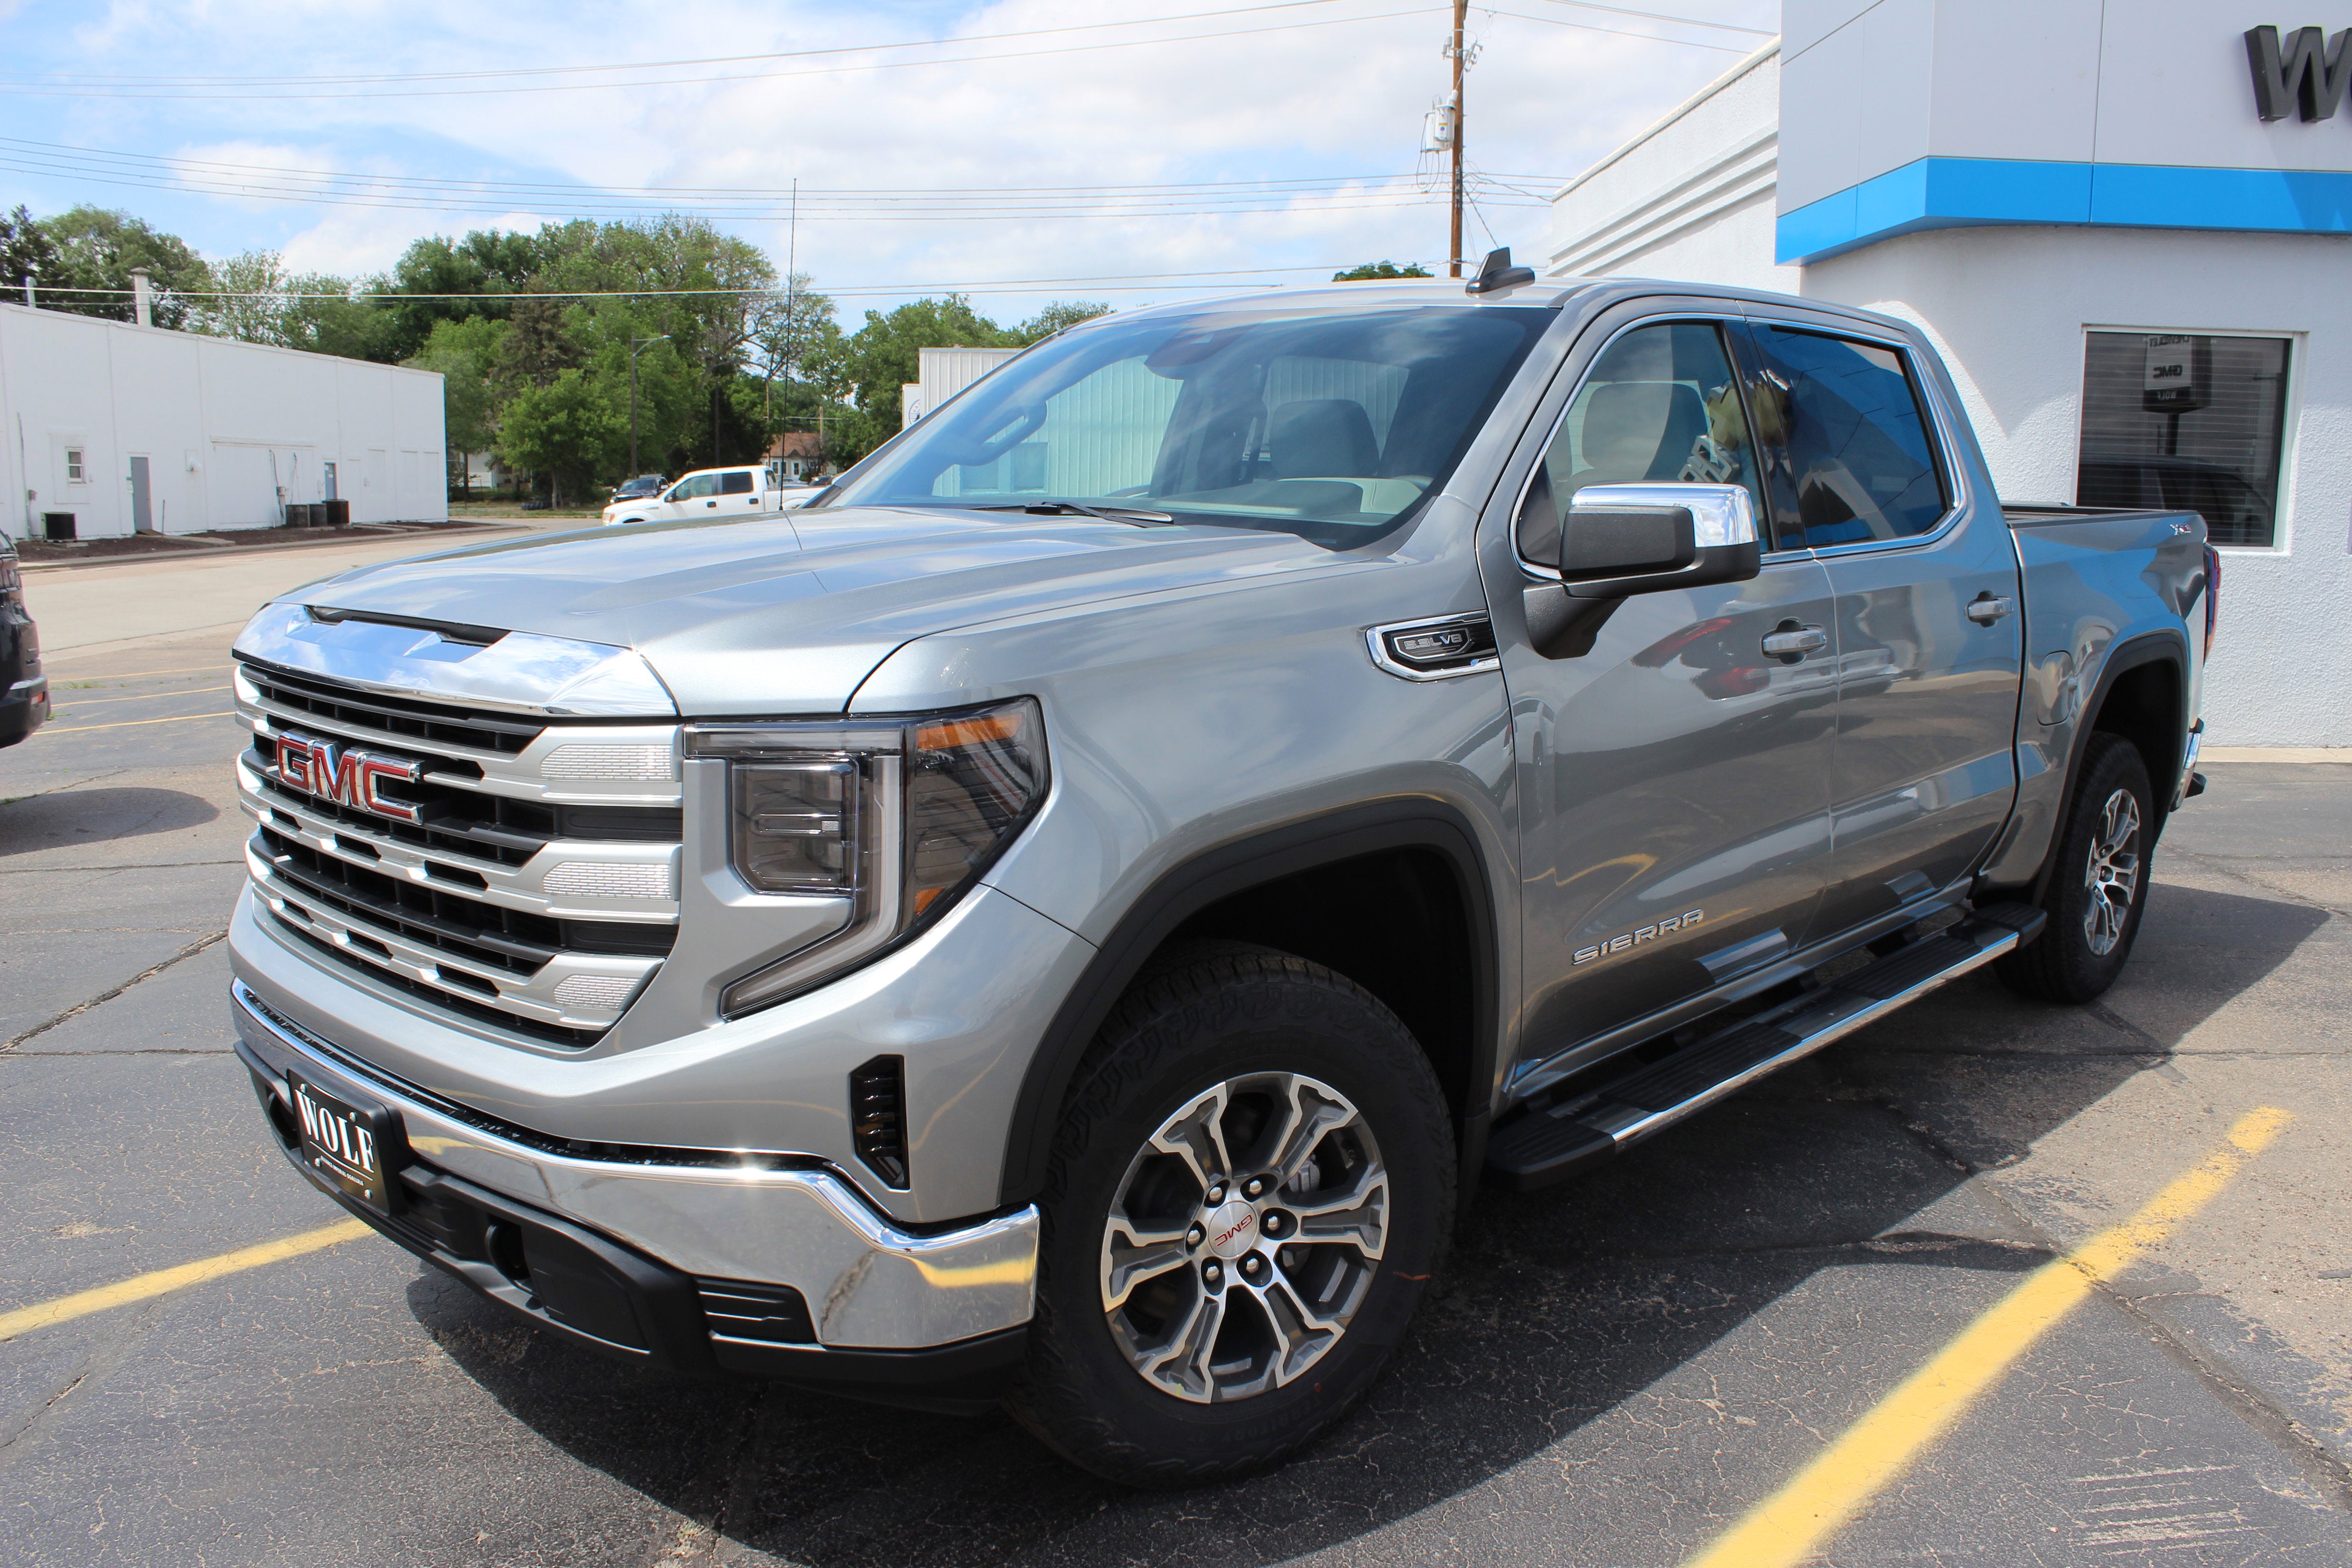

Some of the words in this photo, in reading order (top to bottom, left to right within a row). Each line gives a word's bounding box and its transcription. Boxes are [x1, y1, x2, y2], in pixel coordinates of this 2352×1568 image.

[2244, 25, 2352, 123] W
[277, 731, 423, 825] GMC
[1573, 908, 1704, 965] SIERRA
[295, 1089, 375, 1173] WOLF
[1214, 1213, 1253, 1247] GMC
